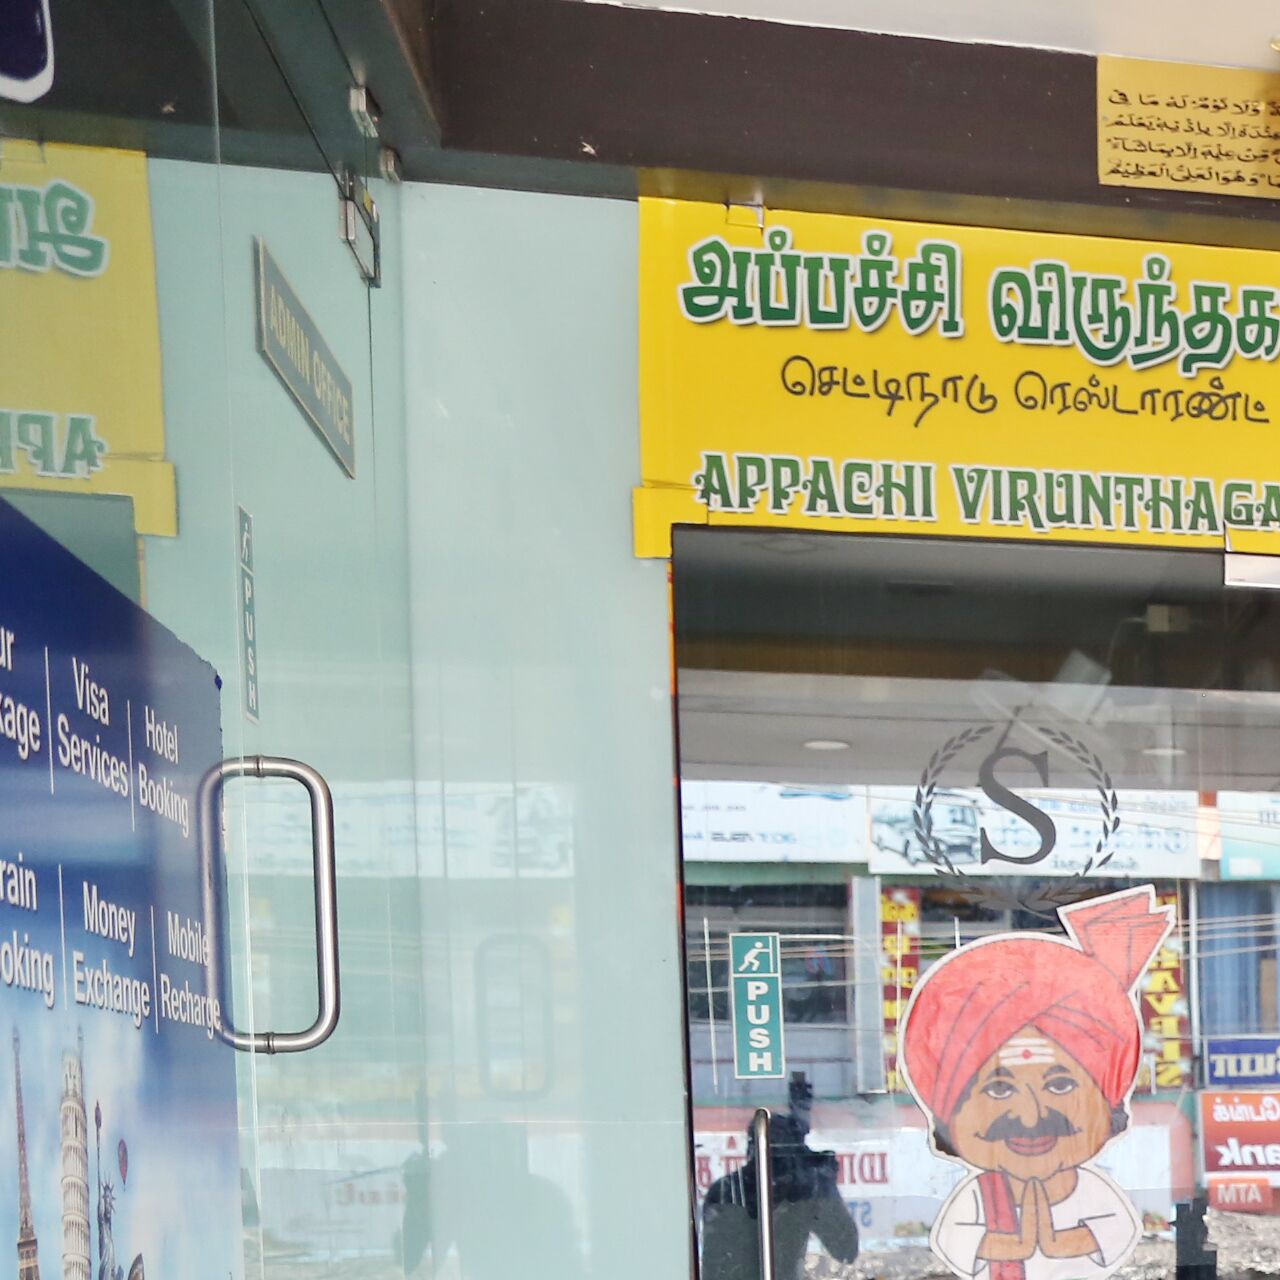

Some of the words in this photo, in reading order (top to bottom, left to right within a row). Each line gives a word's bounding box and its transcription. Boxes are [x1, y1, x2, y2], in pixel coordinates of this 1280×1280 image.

[682, 228, 963, 337] அப்பச்சி
[271, 284, 310, 385] ADMIN
[313, 349, 350, 446] OFFICE
[693, 452, 936, 520] APPACHI
[244, 577, 257, 711] PUSH
[72, 656, 110, 725] Visa
[57, 718, 130, 798] Services
[145, 705, 178, 765] Hotel
[138, 762, 190, 838] Booking
[979, 747, 1056, 865] S
[82, 880, 136, 958] Money
[167, 910, 209, 968] Mobile
[73, 950, 150, 1029] Exchange
[160, 971, 221, 1040] Recharge
[747, 981, 774, 1073] PUSH
